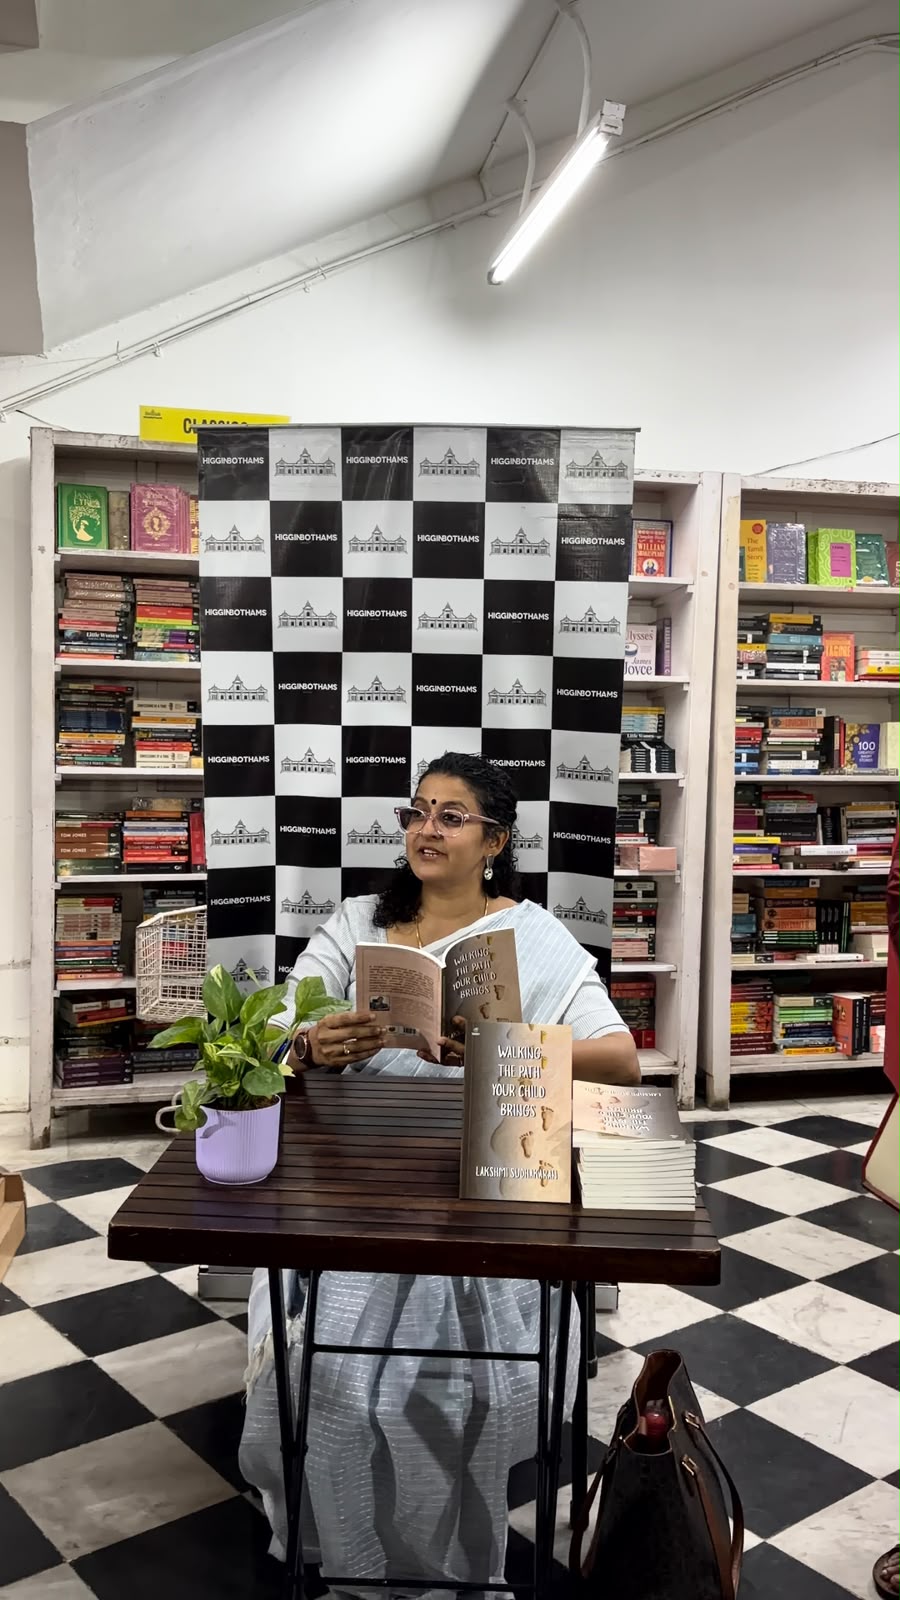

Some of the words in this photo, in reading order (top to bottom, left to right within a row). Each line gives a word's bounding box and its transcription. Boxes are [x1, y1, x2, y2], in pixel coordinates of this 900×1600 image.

[202, 456, 265, 465] HIGGINBOTHAMS
[346, 456, 409, 464] HIGGINBOTHAMS
[490, 457, 555, 466] HIGGINBOTHAMS
[274, 533, 338, 542] HIGGINBOTHAMS
[417, 534, 480, 543] HIGGINBOTHAMS
[560, 536, 626, 546] HIGGINBOTHAMS
[204, 608, 267, 617] HIGGINBOTHAMS
[346, 609, 408, 618] HIGGINBOTHAMS
[487, 612, 550, 621] HIGGINBOTHAMS
[626, 630, 654, 642] lysses
[278, 682, 338, 691] HIGGINBOTHAMS
[416, 684, 478, 693] HIGGINBOTHAMS
[556, 688, 618, 699] HIGGINBOTHAMS
[858, 741, 876, 751] 100
[207, 755, 270, 764] HIGGINBOTHAMS
[345, 756, 407, 764] HIGGINBOTHAMS
[279, 825, 337, 835] HIGGINBOTHAMS
[552, 831, 611, 844] HIGGINBOTHAMS
[210, 895, 271, 906] HIGGINBOTHAMS
[453, 948, 490, 966] WALKING
[456, 965, 469, 977] THE
[471, 960, 491, 971] PATH
[452, 977, 471, 991] YOUR
[473, 972, 497, 984] CHILD
[460, 985, 490, 999] BRINGS
[497, 1045, 542, 1059] WALKING
[498, 1064, 516, 1078] THE
[518, 1065, 541, 1079] PATH
[492, 1083, 516, 1097] YOUR
[518, 1084, 546, 1098] CHILD
[500, 1102, 537, 1117] BRINGS
[475, 1165, 509, 1178] LAKSHMI
